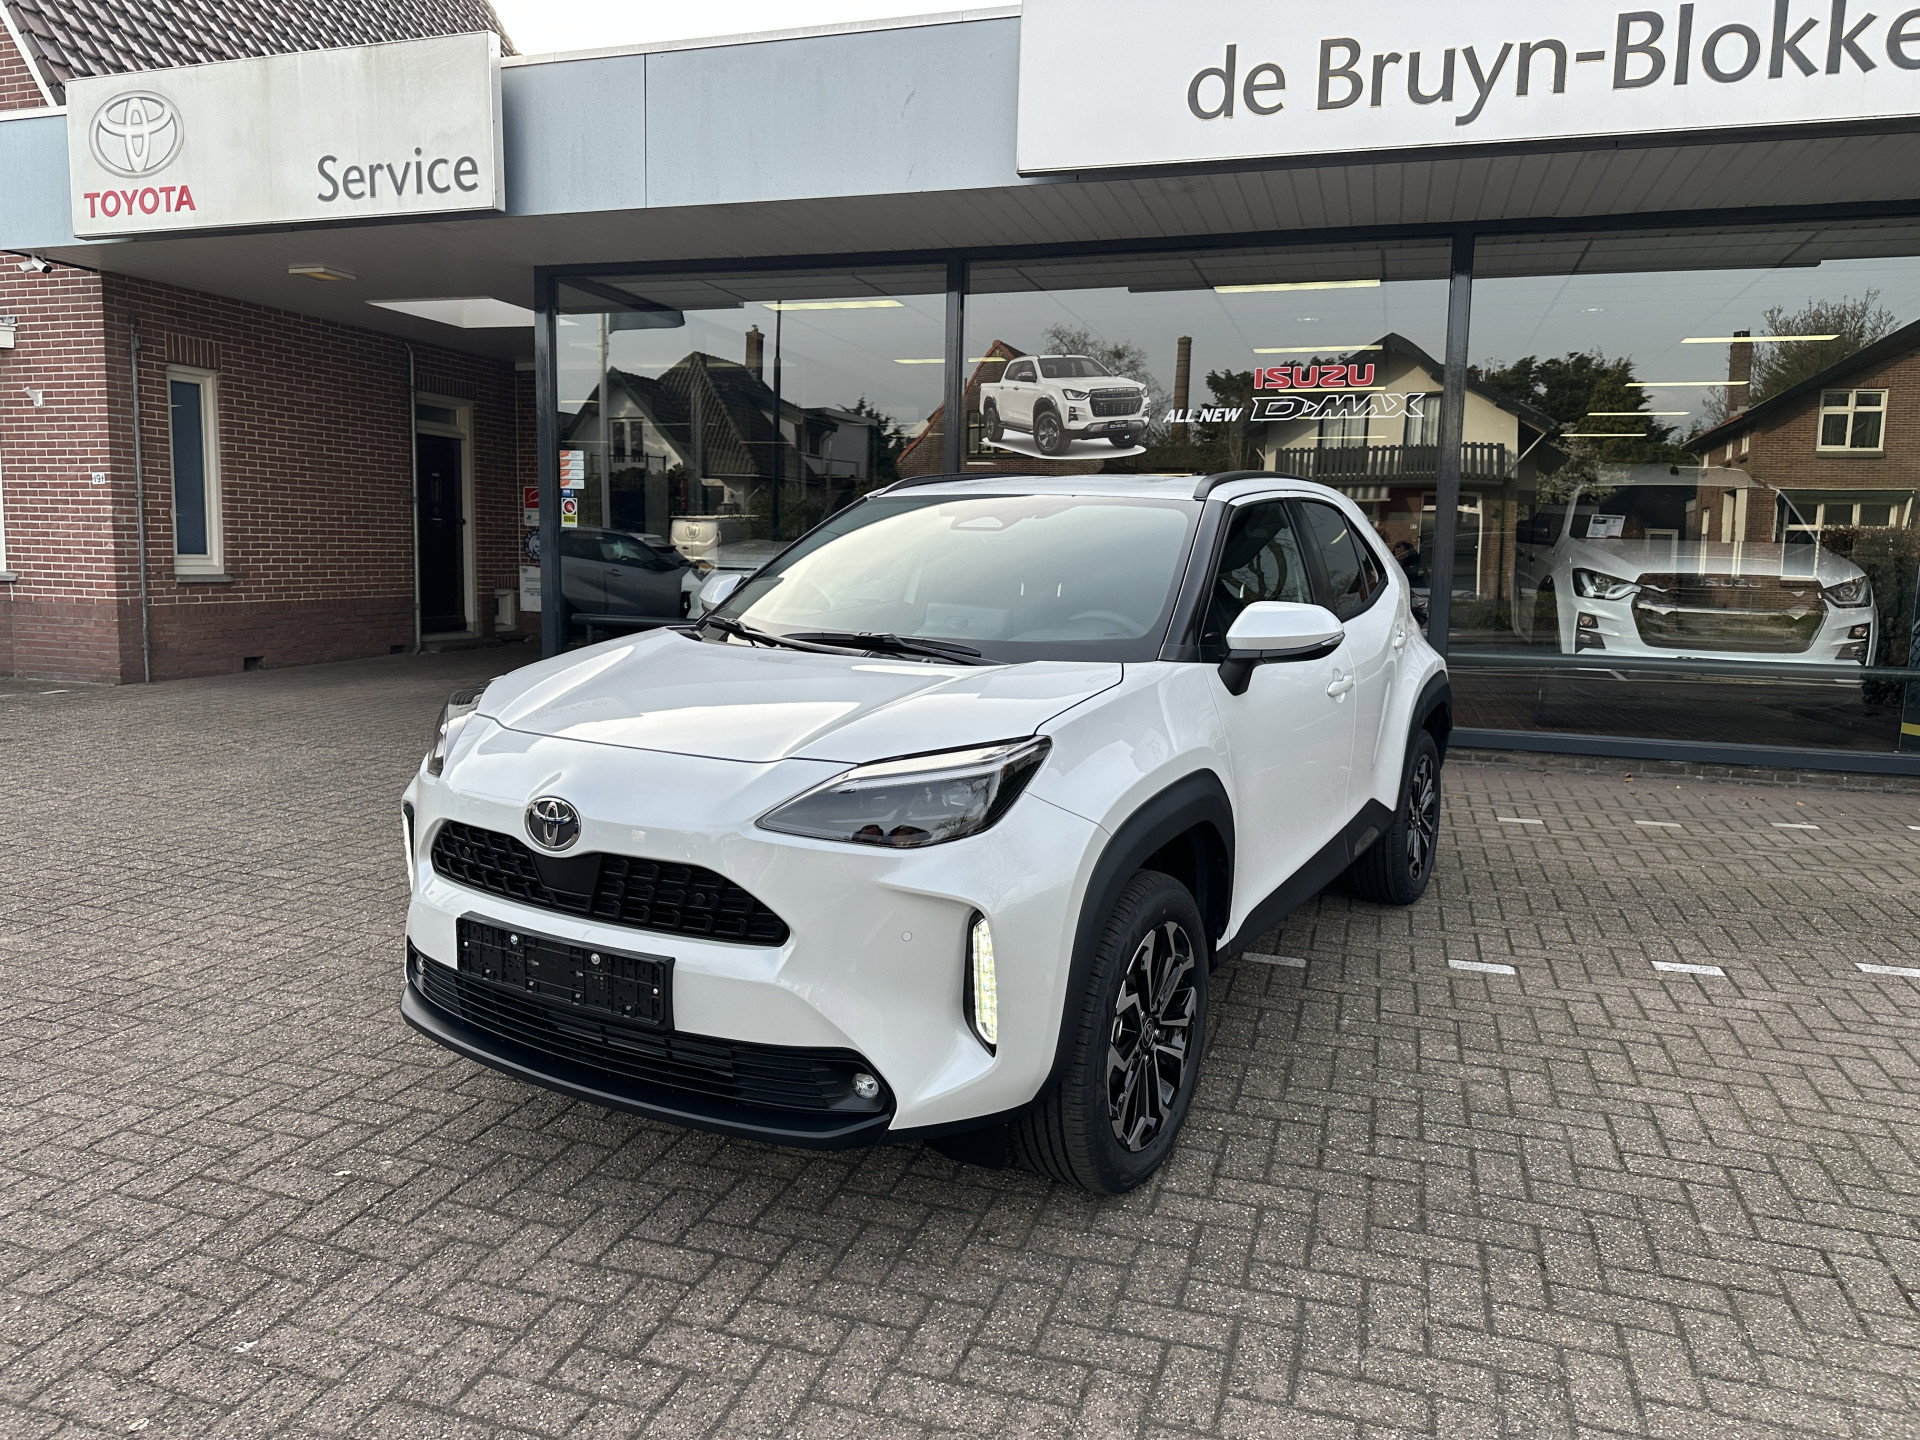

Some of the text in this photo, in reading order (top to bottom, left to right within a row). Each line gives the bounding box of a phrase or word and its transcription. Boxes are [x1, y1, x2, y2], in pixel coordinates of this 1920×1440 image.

[1187, 43, 1286, 120] de
[317, 147, 479, 202] Service
[83, 185, 196, 219] TOYOTA
[1254, 363, 1376, 390] ISUZU
[1162, 408, 1194, 424] ALL
[1199, 407, 1244, 423] NEW
